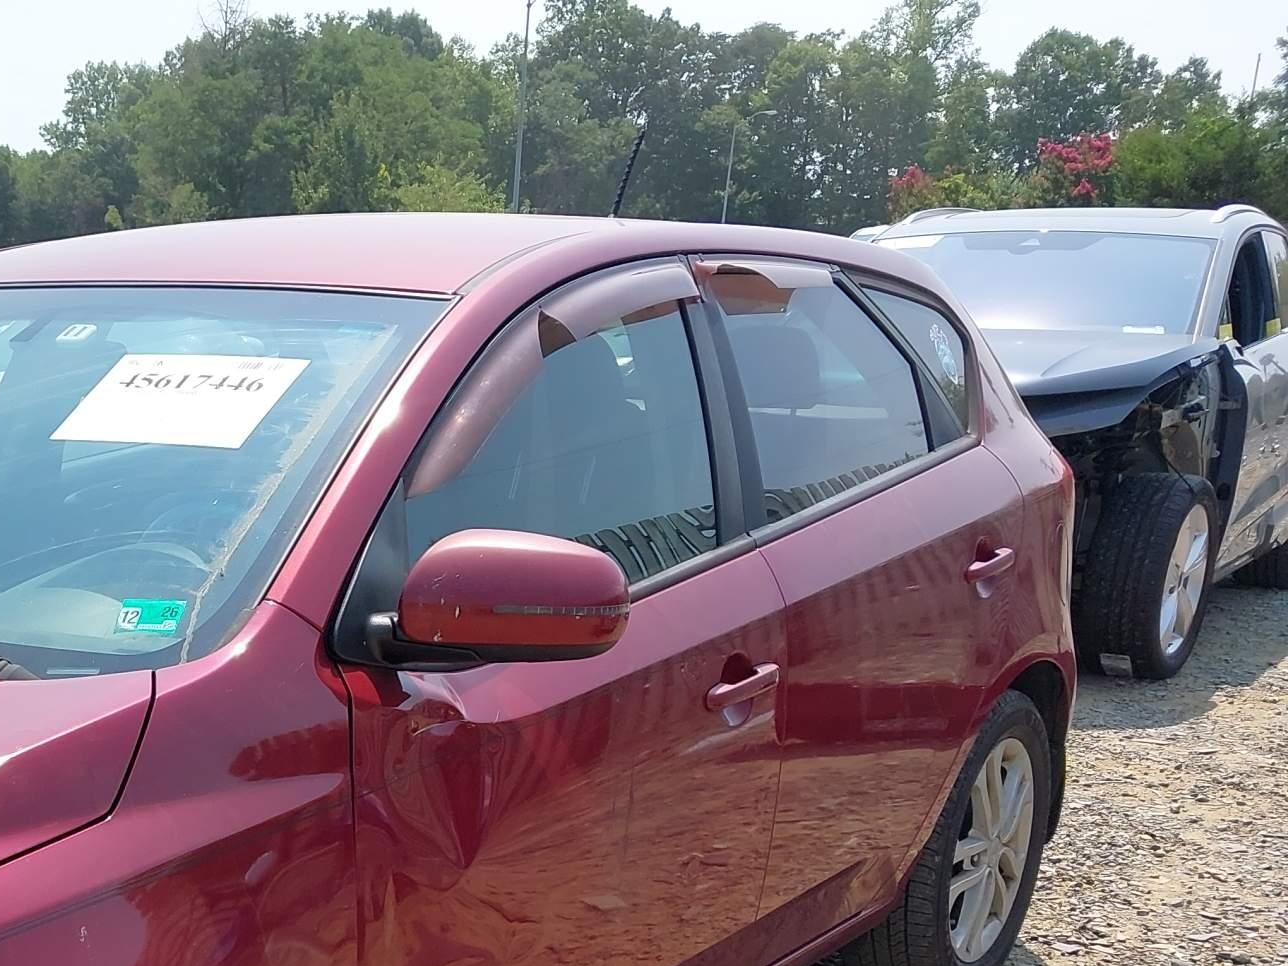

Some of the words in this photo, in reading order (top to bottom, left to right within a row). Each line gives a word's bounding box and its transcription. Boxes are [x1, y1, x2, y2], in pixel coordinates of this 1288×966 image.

[119, 372, 265, 392] 45617446
[121, 610, 140, 625] 12
[160, 606, 180, 618] 26
